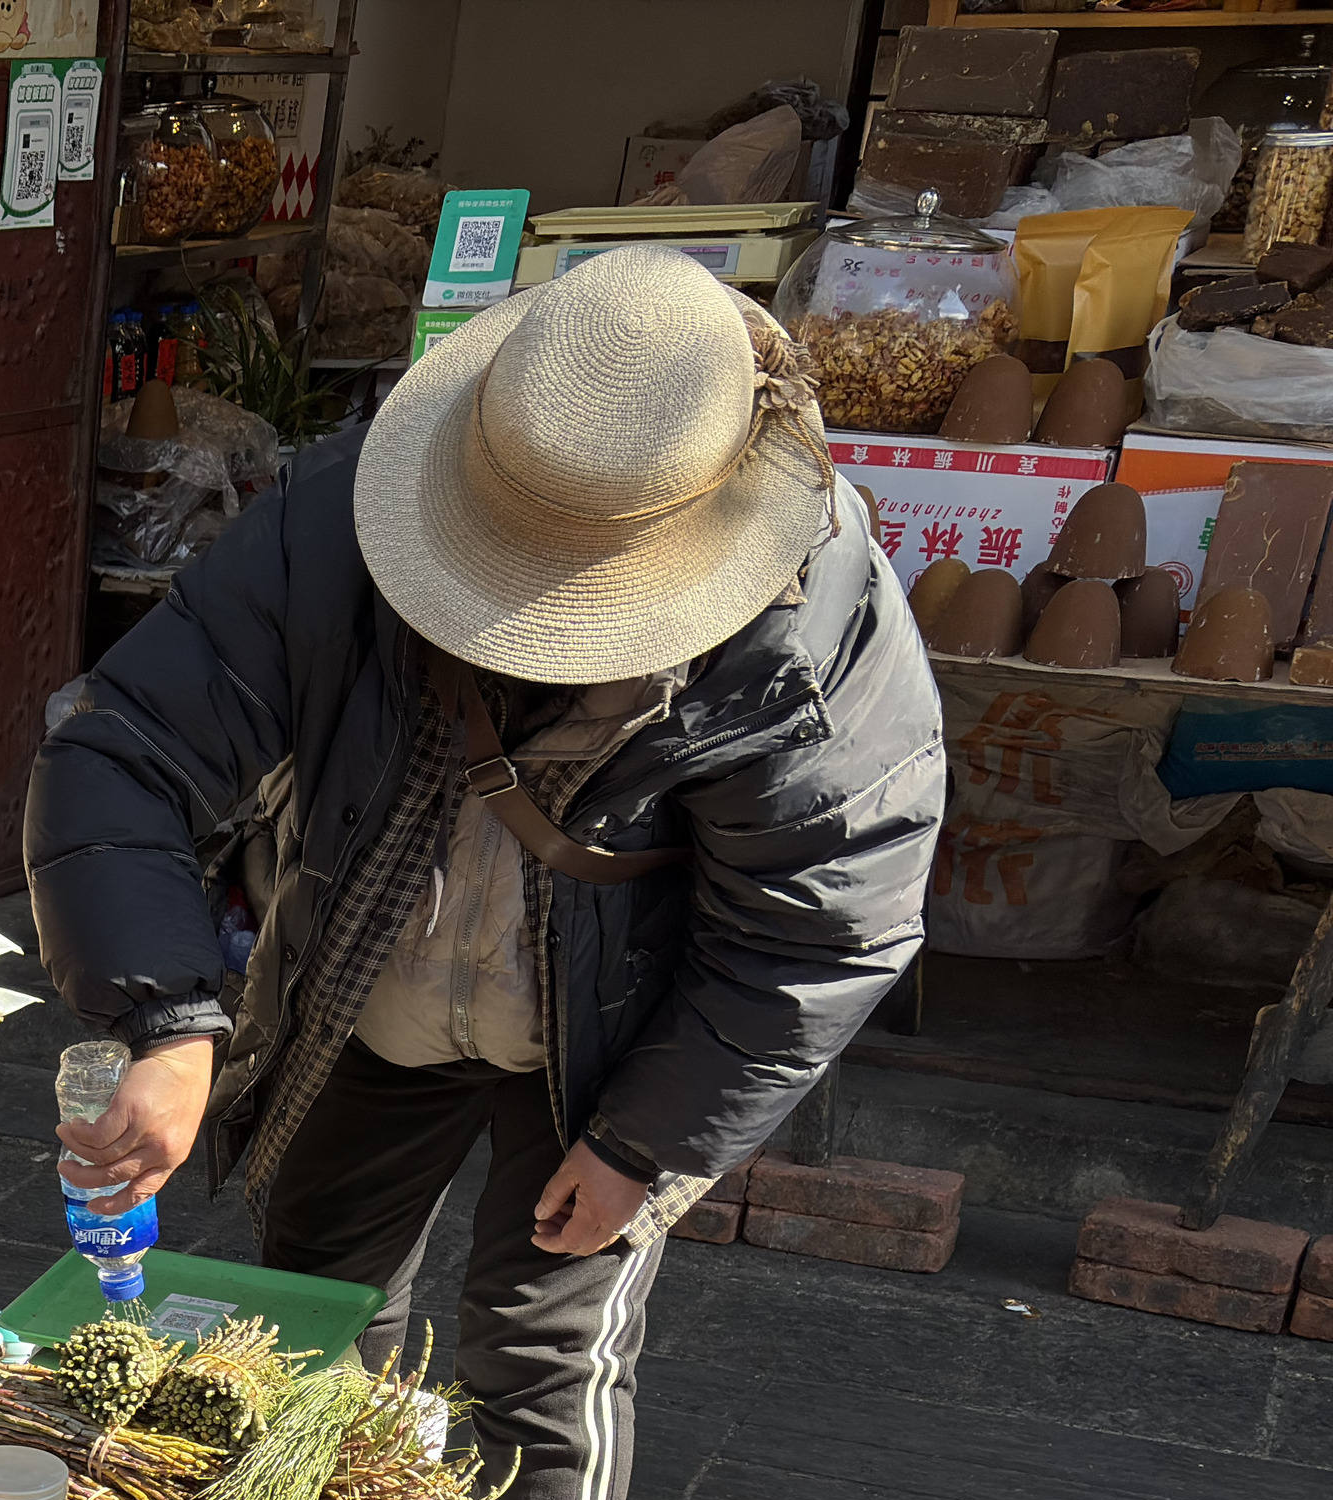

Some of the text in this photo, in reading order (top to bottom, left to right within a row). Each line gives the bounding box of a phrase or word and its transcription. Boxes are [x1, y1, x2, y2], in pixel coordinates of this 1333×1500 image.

[456, 289, 491, 299] 微信支付
[74, 1226, 134, 1247] 大理山泉
